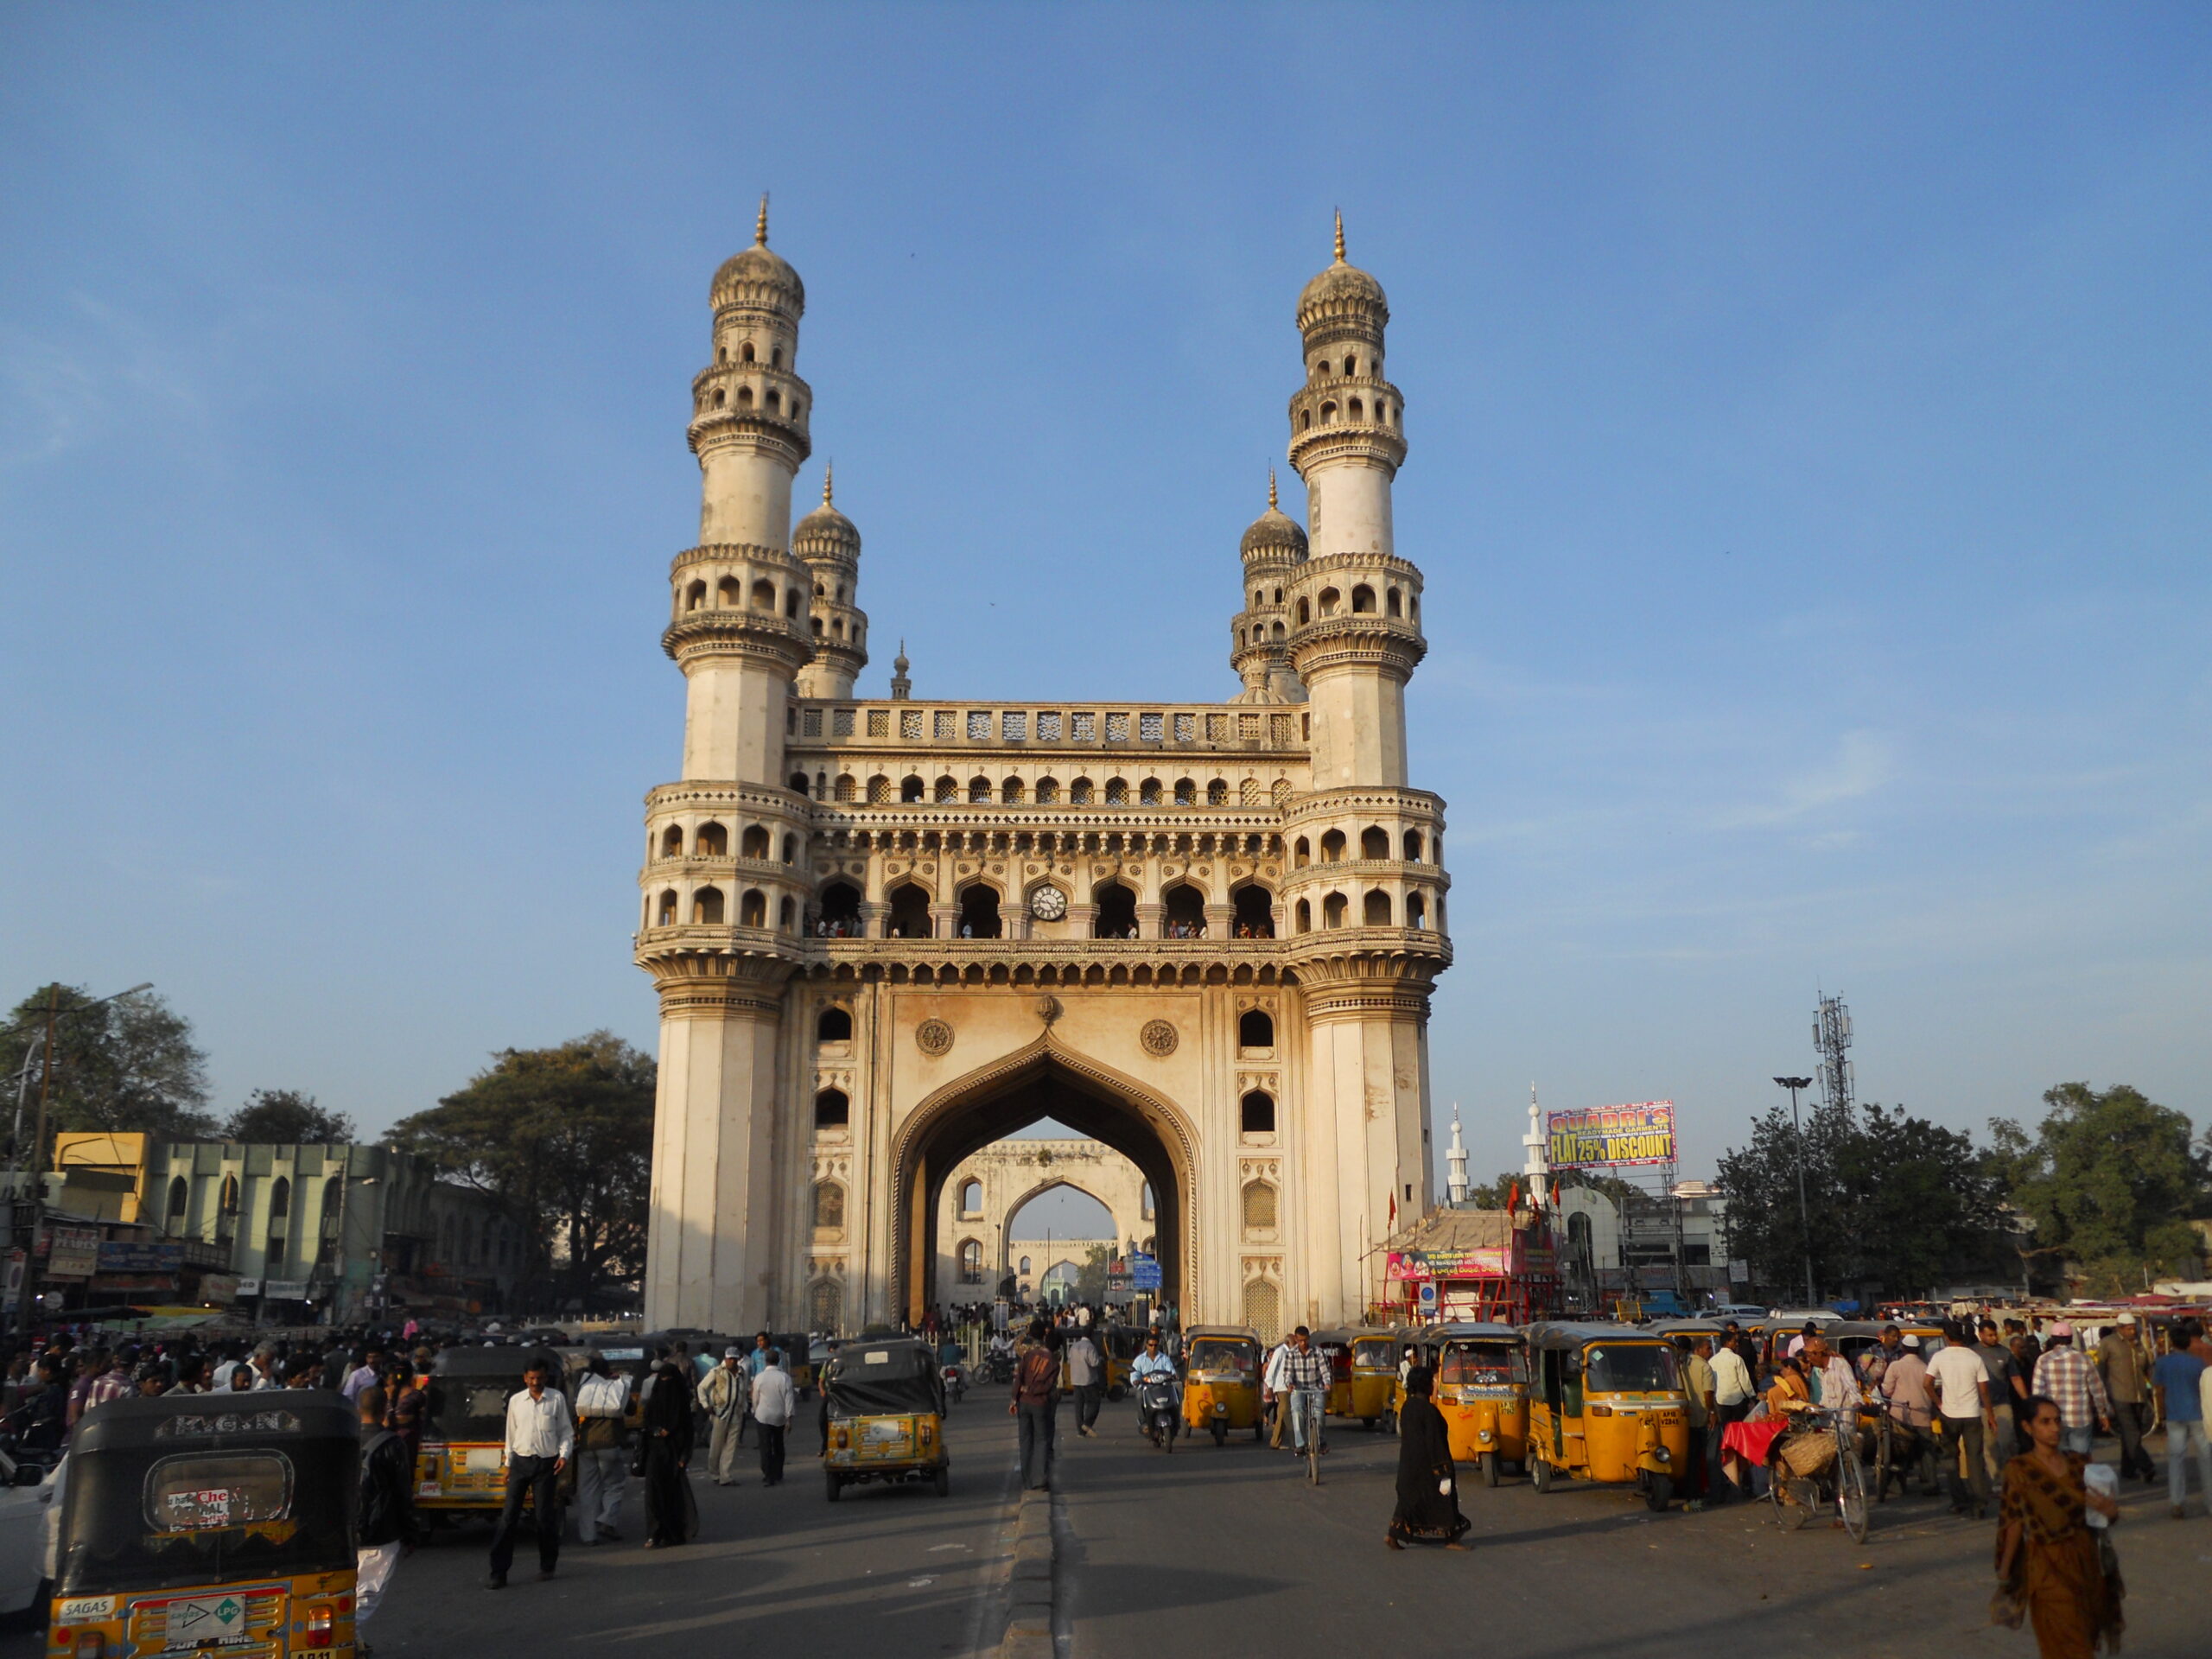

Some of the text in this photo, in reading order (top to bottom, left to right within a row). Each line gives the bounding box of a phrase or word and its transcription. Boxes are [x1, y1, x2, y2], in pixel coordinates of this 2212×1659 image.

[1551, 1108, 1669, 1134] QUADRI'S
[1577, 1124, 1669, 1136] READYMADE GARMENTS
[1551, 1134, 1671, 1163] FLAT 25% DISCOUNT
[65, 1600, 108, 1616] SAGAS
[217, 1606, 239, 1617] LPG
[170, 1610, 200, 1620] sagas
[218, 1634, 255, 1645] HIRE
